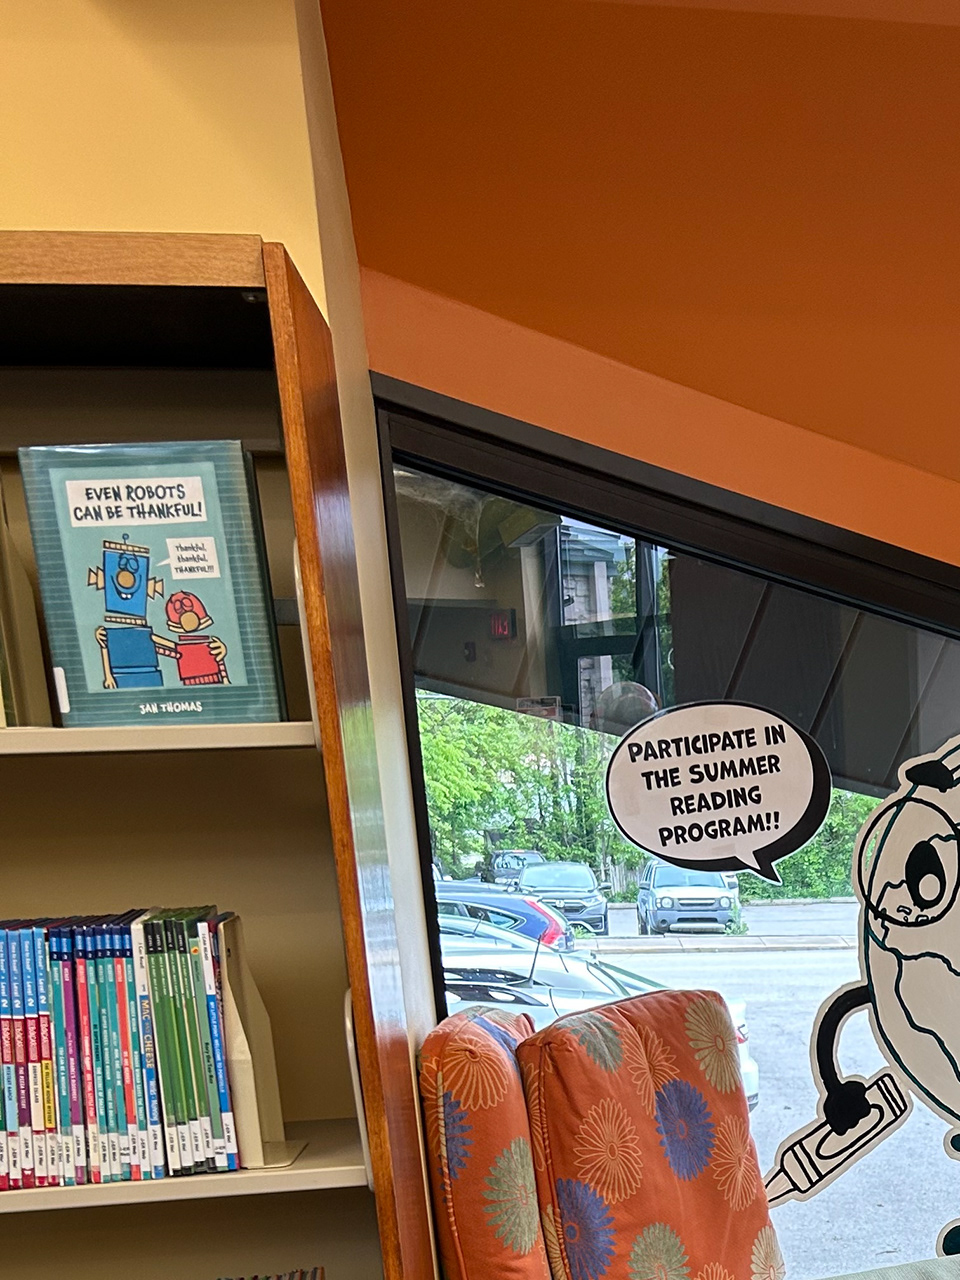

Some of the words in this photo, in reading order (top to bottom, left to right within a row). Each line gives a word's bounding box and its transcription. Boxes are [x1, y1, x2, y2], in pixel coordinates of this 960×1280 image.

[85, 485, 122, 500] EVEN
[125, 484, 186, 500] ROBOTS
[73, 504, 103, 521] CAN
[107, 504, 123, 519] BE
[126, 502, 202, 519] THANKFUL!
[139, 703, 159, 714] JAN
[160, 701, 203, 713] THOMAS
[627, 728, 758, 763] PARTICIPATE
[764, 724, 786, 746] IN
[640, 767, 682, 791] THE
[689, 754, 781, 784] SUMMER
[669, 785, 762, 816] READING
[658, 811, 780, 847] PROGRAM!!
[141, 1000, 150, 1020] MAC
[143, 1034, 154, 1068] CHEESE
